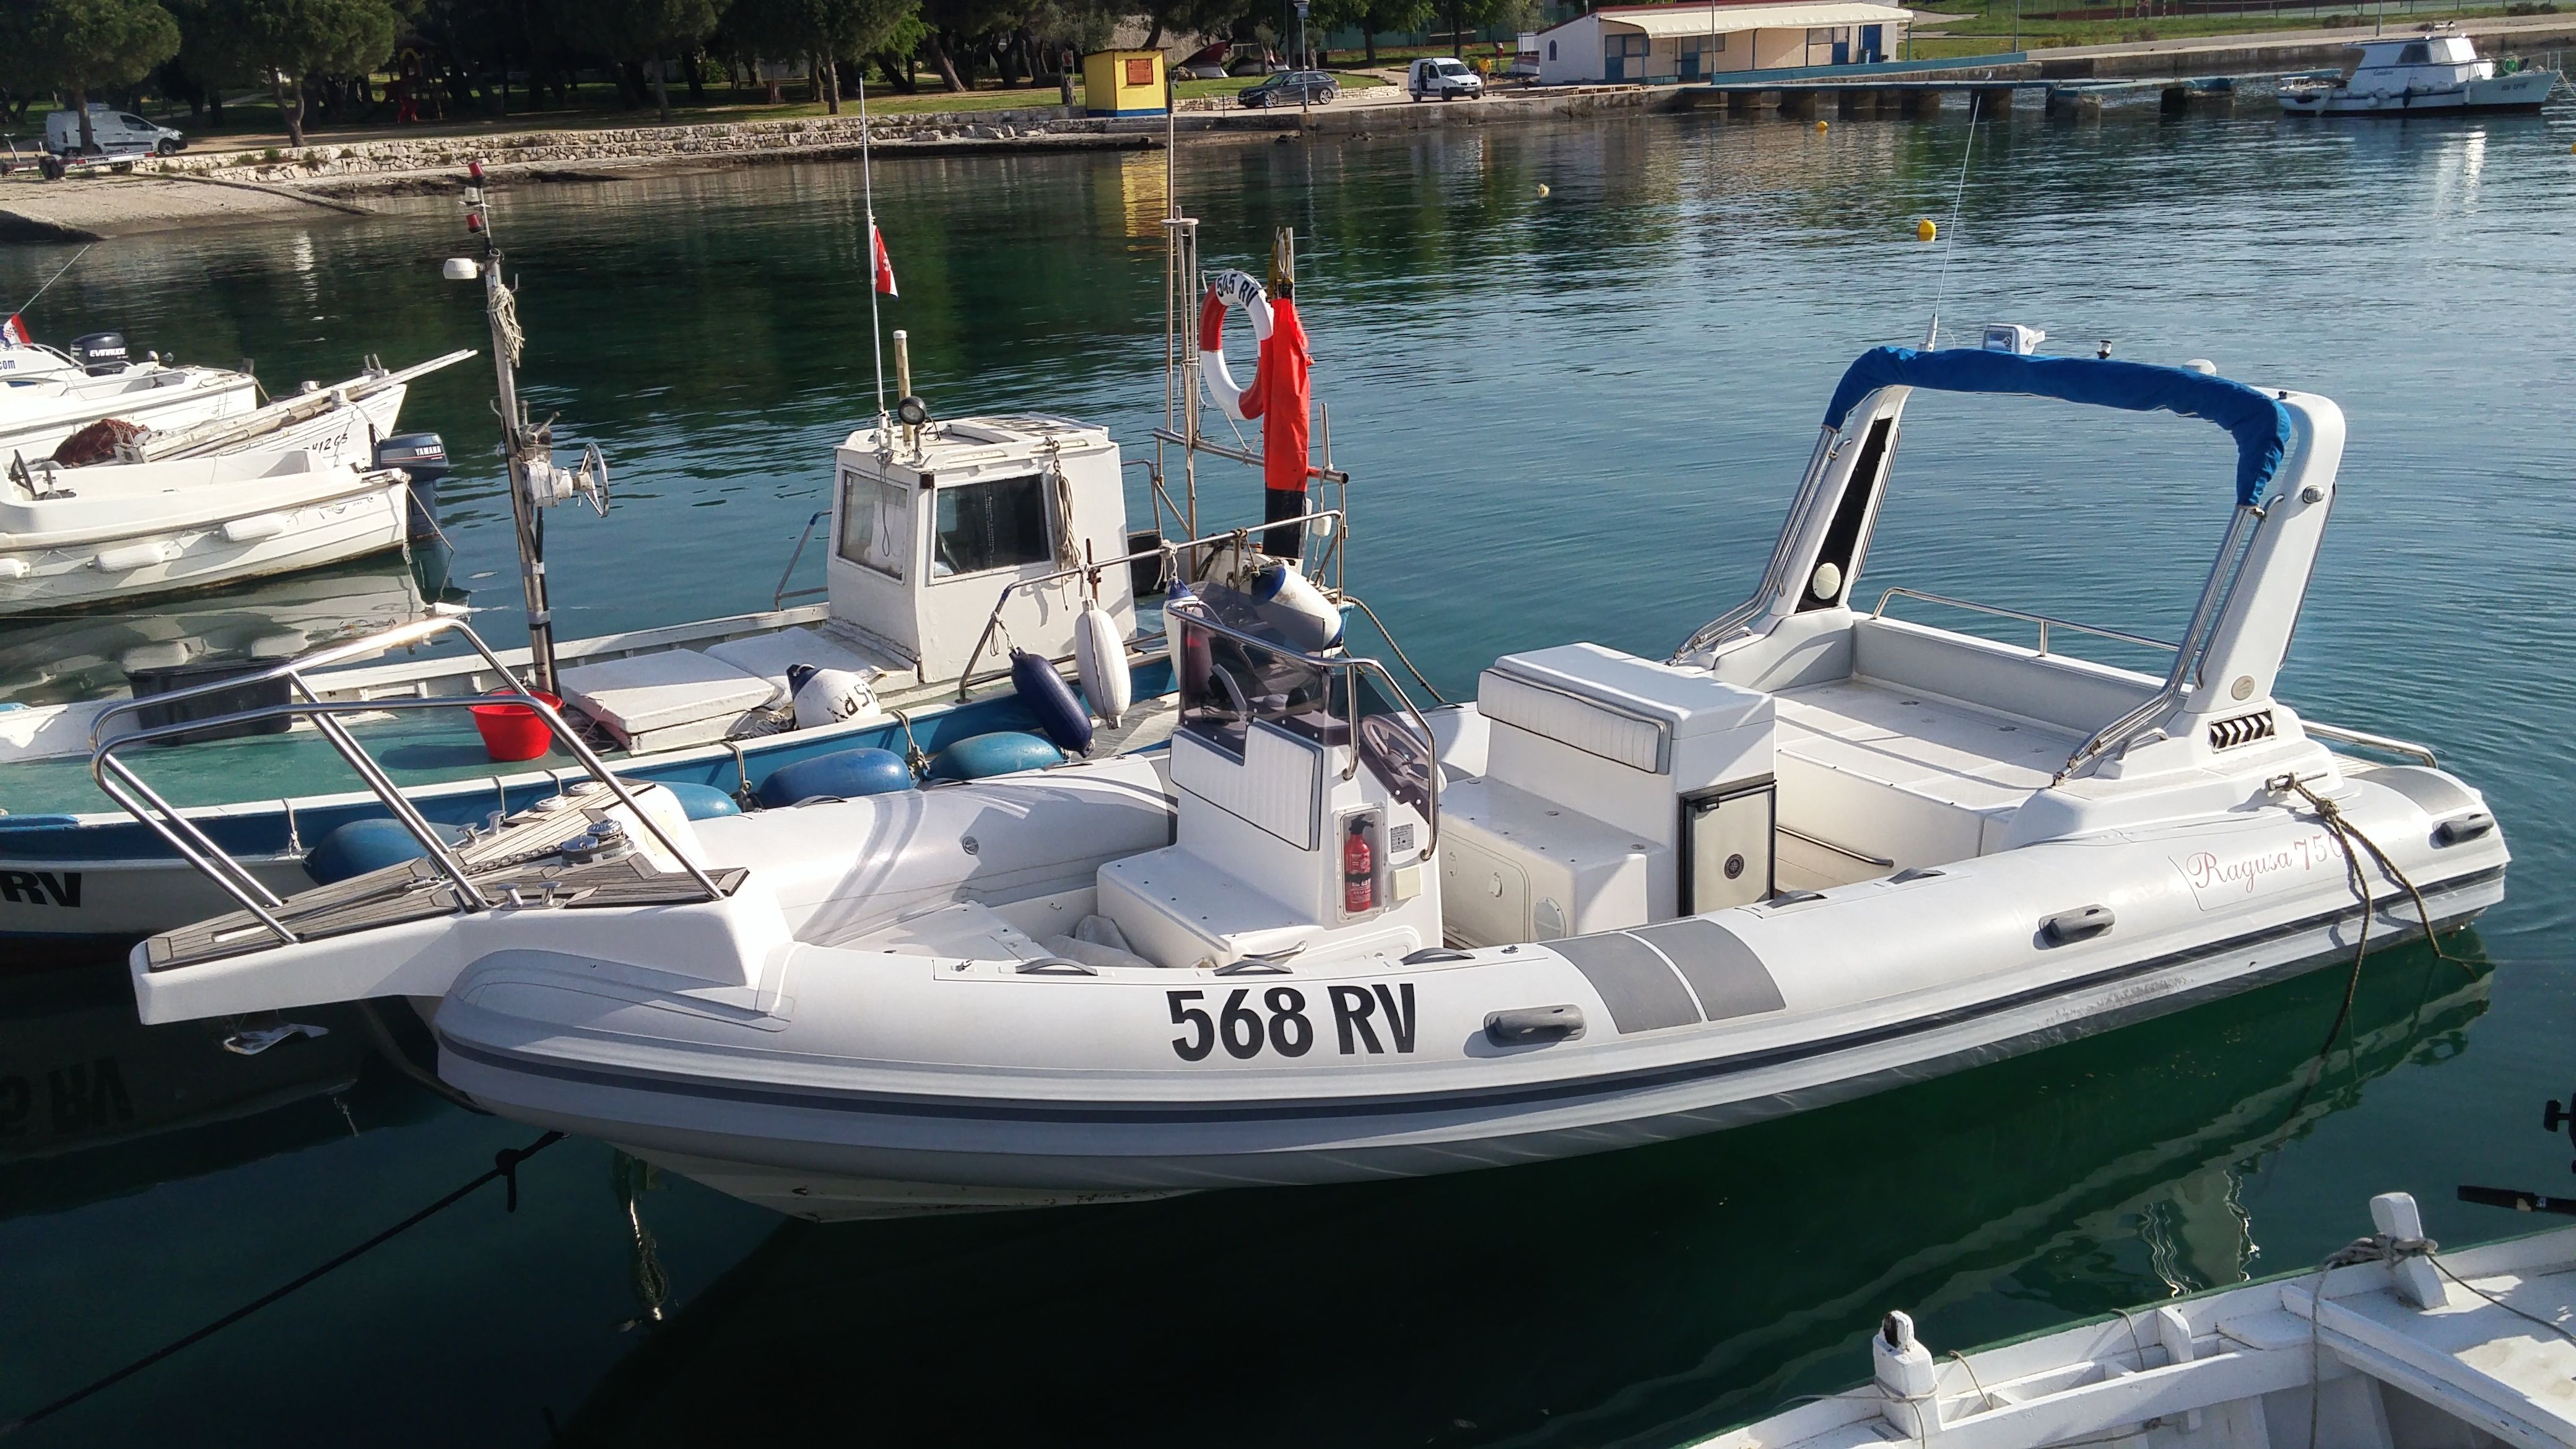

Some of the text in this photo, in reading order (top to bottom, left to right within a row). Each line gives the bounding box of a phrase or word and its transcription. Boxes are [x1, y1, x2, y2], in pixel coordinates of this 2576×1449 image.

[1217, 273, 1259, 308] 545 RV
[89, 347, 126, 357] EVINRUDE
[414, 445, 442, 456] YAMAHA
[0, 870, 82, 908] RV
[2186, 851, 2292, 893] Ragusa
[1165, 983, 1416, 1062] 568 RV
